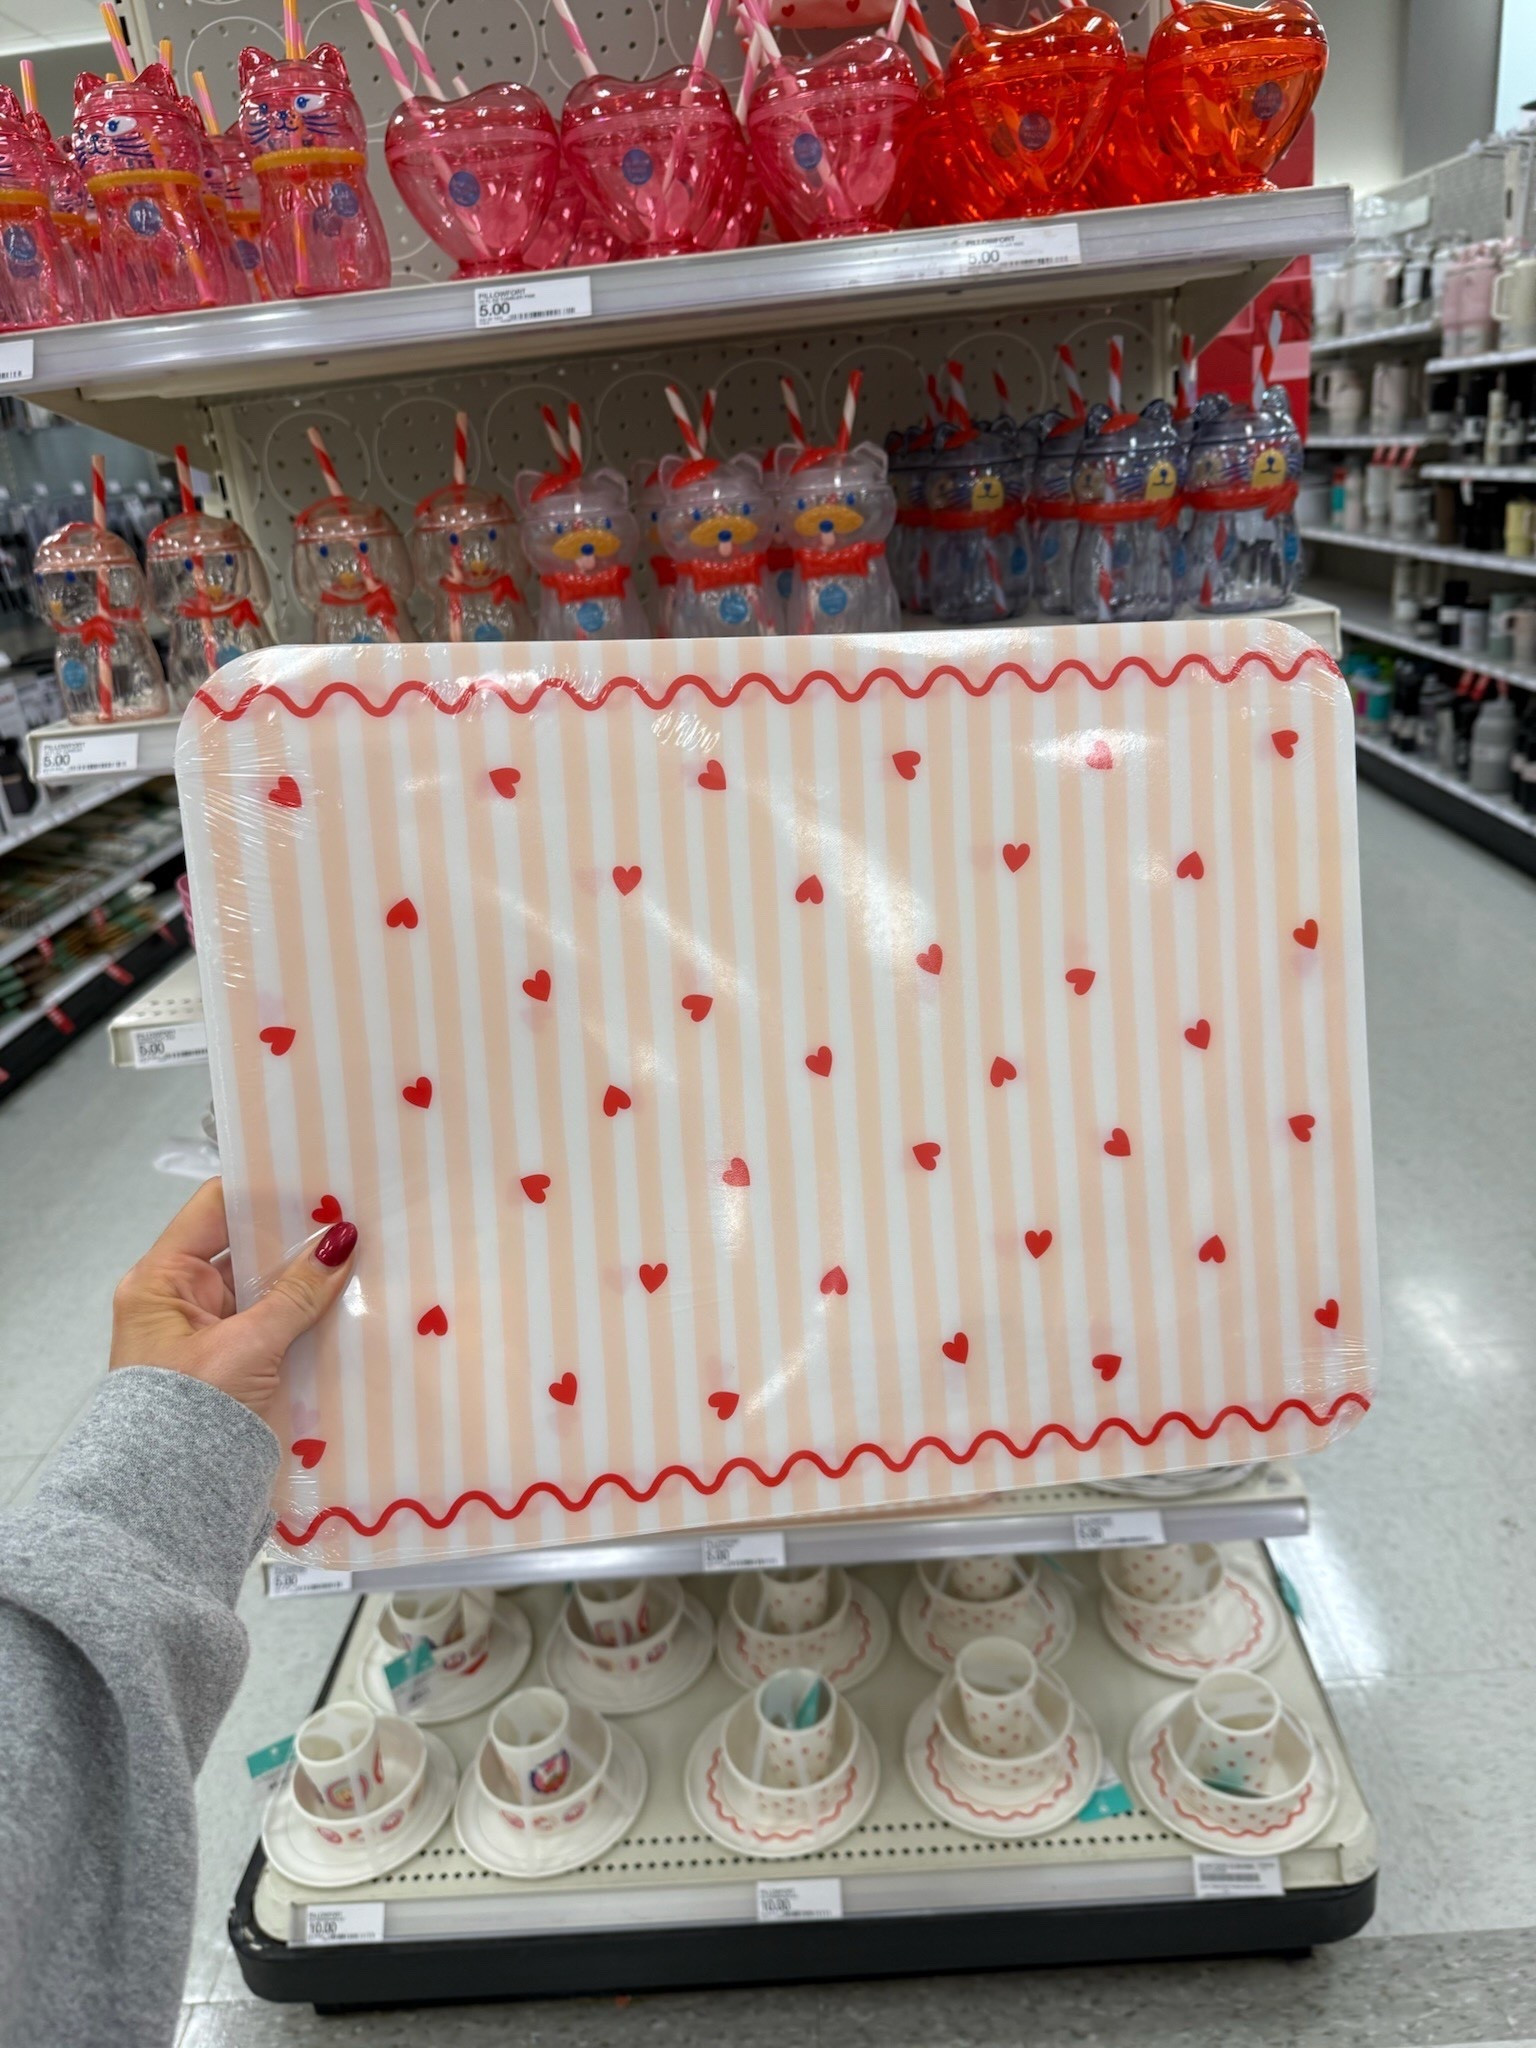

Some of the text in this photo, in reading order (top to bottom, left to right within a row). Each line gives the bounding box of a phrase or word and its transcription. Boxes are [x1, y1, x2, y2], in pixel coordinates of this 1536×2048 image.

[968, 250, 1000, 265] 5.00
[479, 302, 511, 317] 5.00
[43, 755, 71, 768] 5.00
